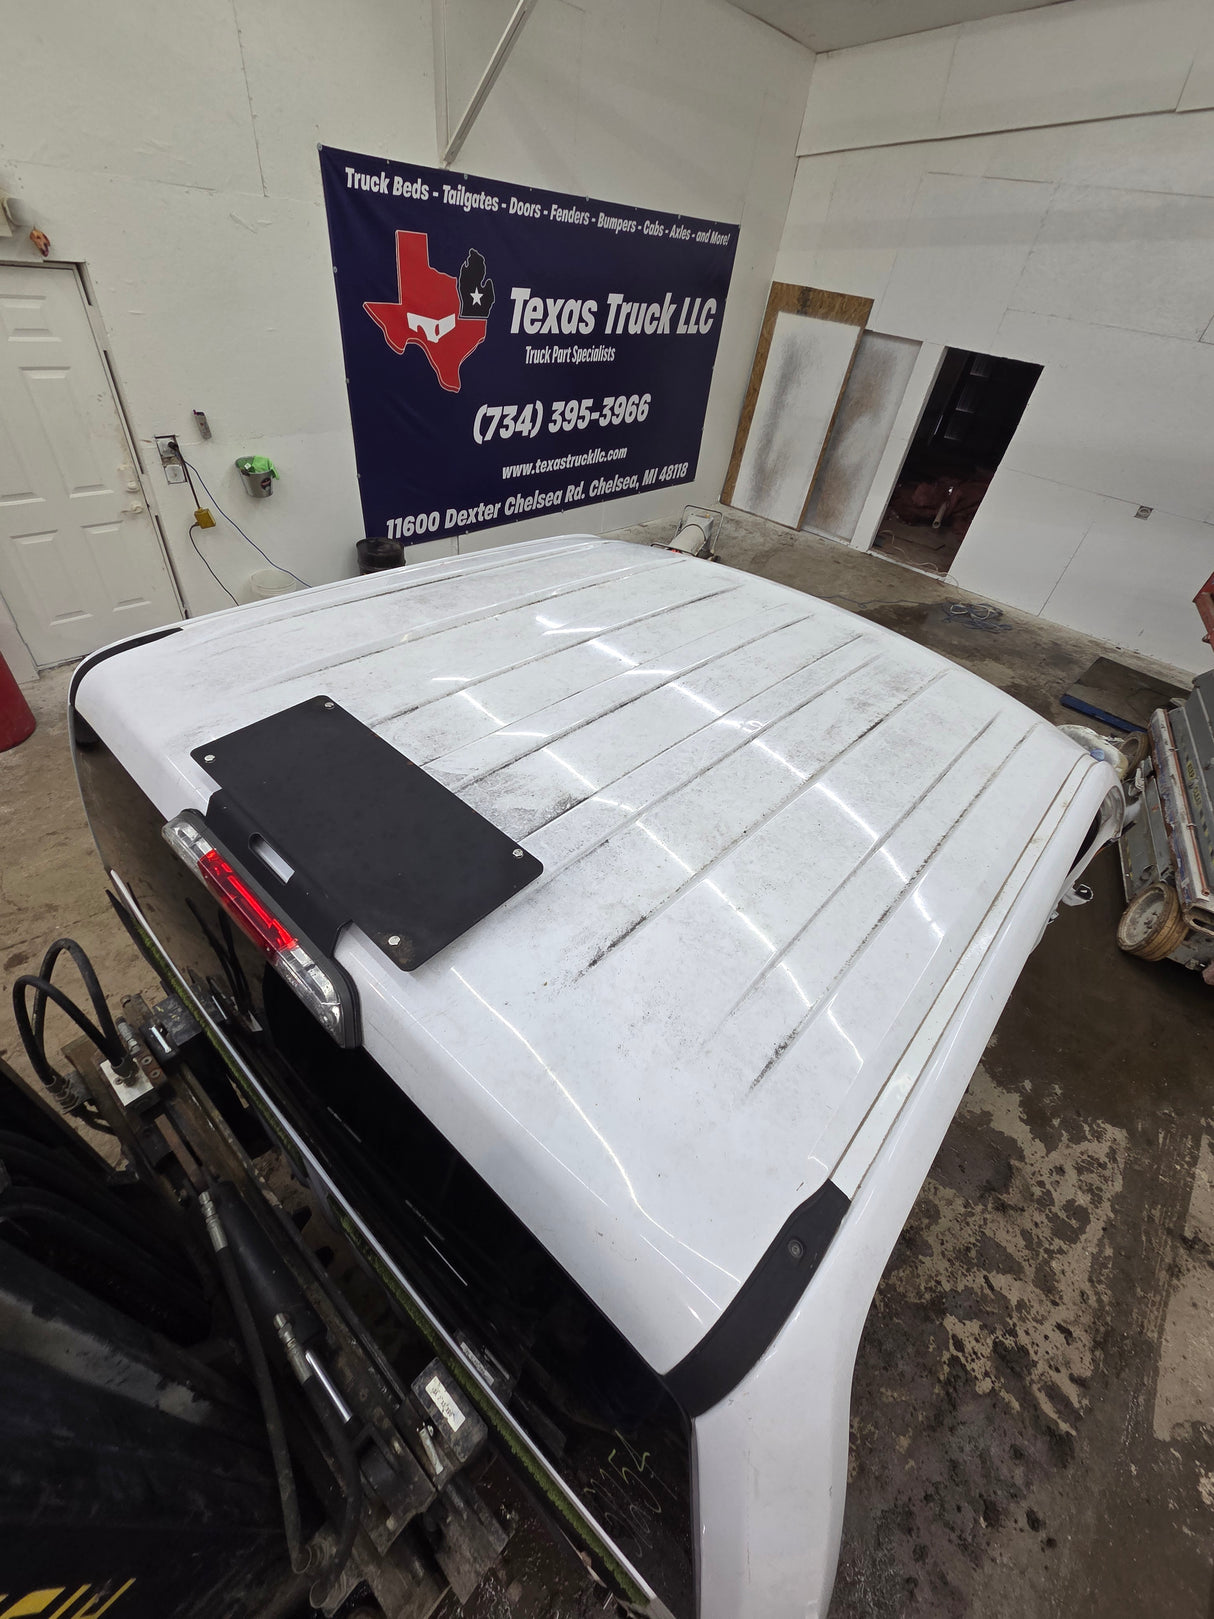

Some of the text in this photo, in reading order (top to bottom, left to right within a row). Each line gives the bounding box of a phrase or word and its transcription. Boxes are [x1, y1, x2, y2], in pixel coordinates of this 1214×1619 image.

[345, 167, 390, 194] Truck
[392, 176, 429, 200] Beds
[442, 184, 499, 212] Tailgates
[509, 197, 541, 218] Doors
[550, 204, 590, 225] Fenders
[597, 212, 637, 234] Bumpers
[643, 220, 664, 237] Cabs
[669, 224, 691, 240] Axles
[696, 230, 710, 243] and
[709, 231, 731, 246] More!
[510, 287, 717, 335] Texas Truck LLC
[525, 345, 616, 365] Truck Part Specialists
[473, 393, 651, 444] (734) 395-3966
[502, 447, 627, 479] www.texastruckllc.com
[386, 462, 689, 539] 11600 Dexter Chelsea Rd. Chelsea, MI 48118
